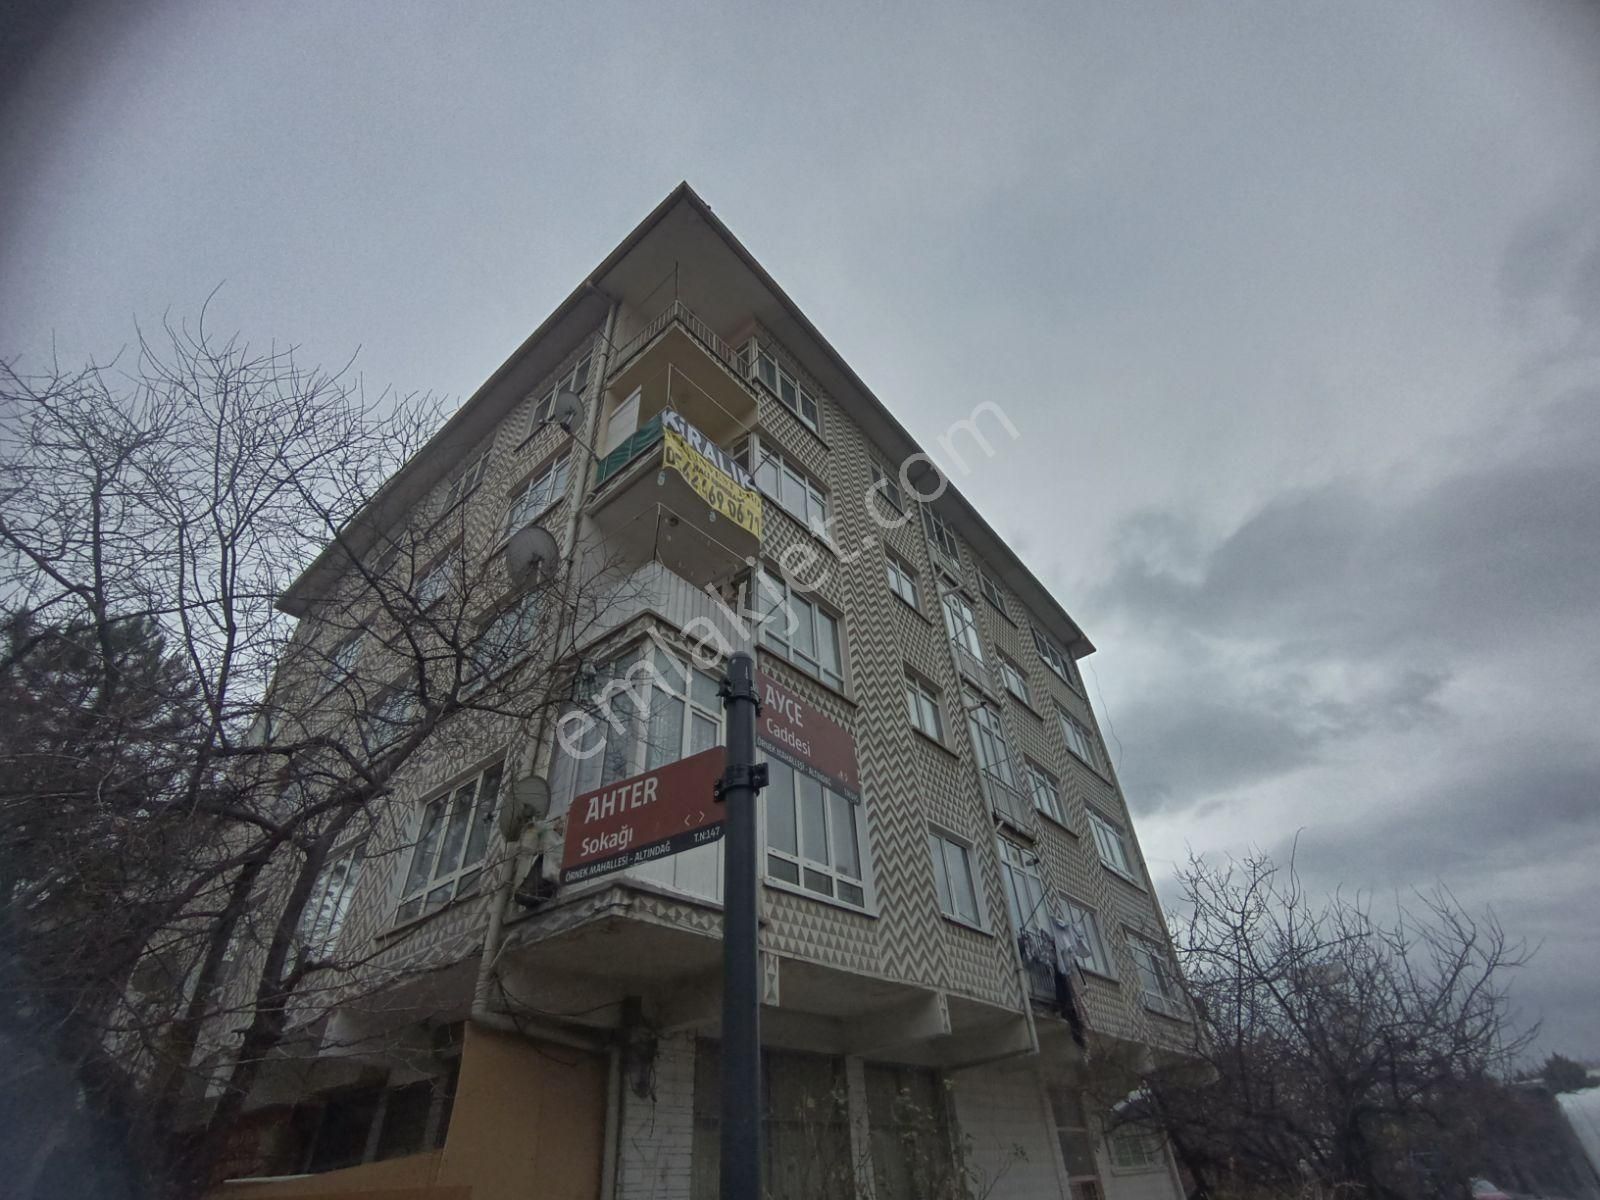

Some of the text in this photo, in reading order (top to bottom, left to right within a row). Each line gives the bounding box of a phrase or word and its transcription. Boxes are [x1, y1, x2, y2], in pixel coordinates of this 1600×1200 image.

[764, 683, 804, 728] AYÇE
[766, 718, 811, 757] Caddesi
[584, 777, 659, 824] AHTER
[565, 866, 589, 882] ÖRNEK
[589, 852, 629, 875] MAHALLESİ
[634, 840, 671, 863] ALTINDAĞ
[580, 825, 633, 857] Sokağı
